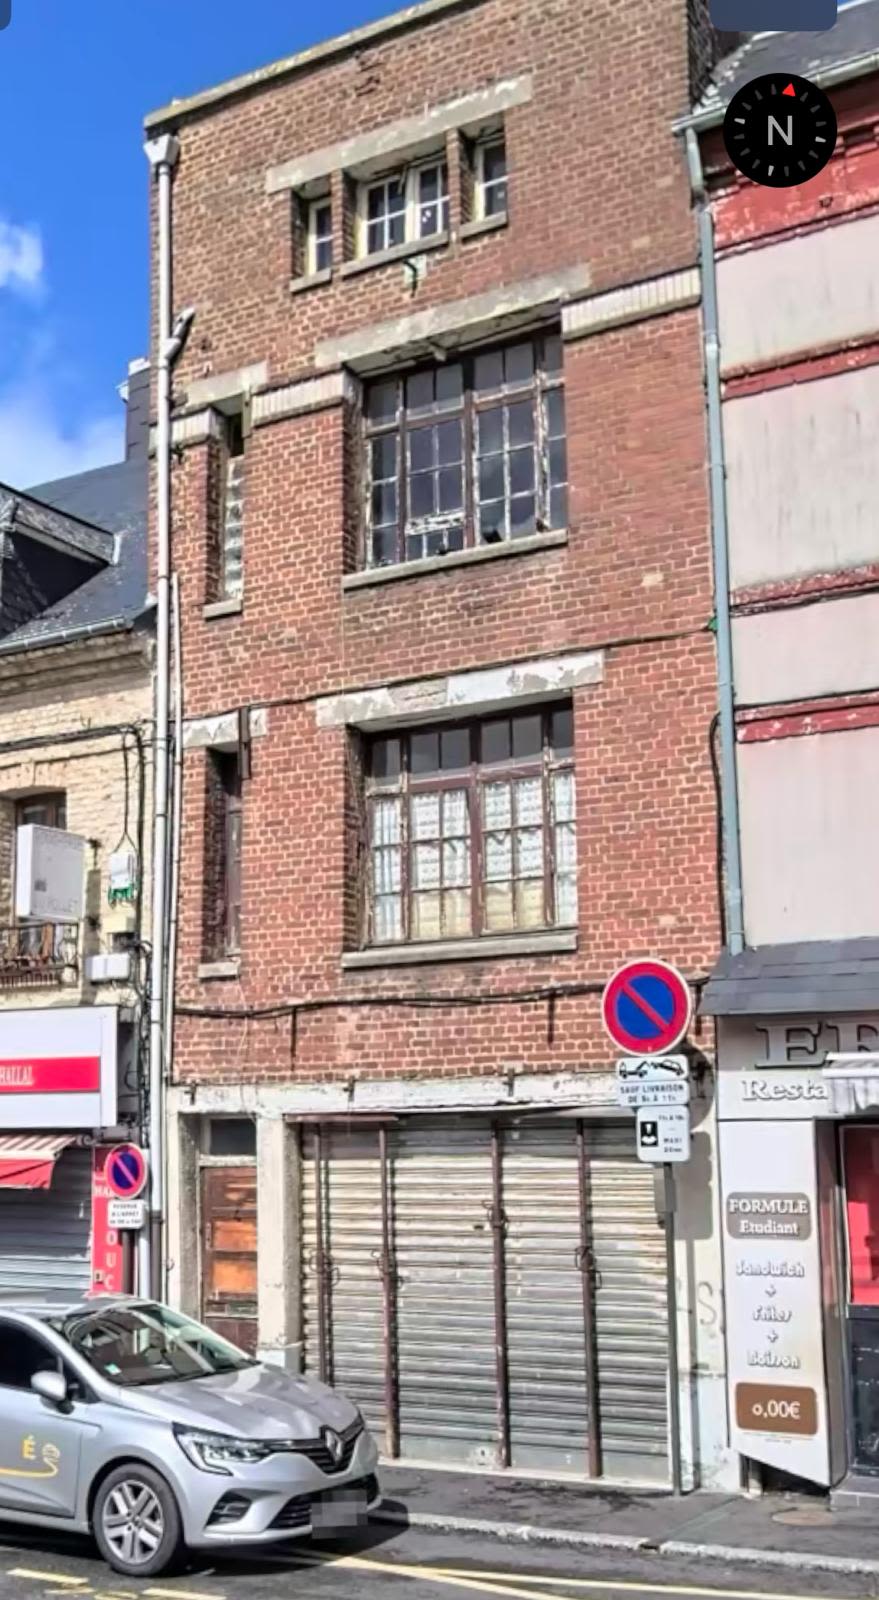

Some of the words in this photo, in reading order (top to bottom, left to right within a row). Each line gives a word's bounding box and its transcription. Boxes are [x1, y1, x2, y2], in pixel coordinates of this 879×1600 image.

[729, 1199, 809, 1214] FORMULE
[739, 1219, 800, 1236] Etudiant
[736, 1259, 805, 1278] Sandwich
